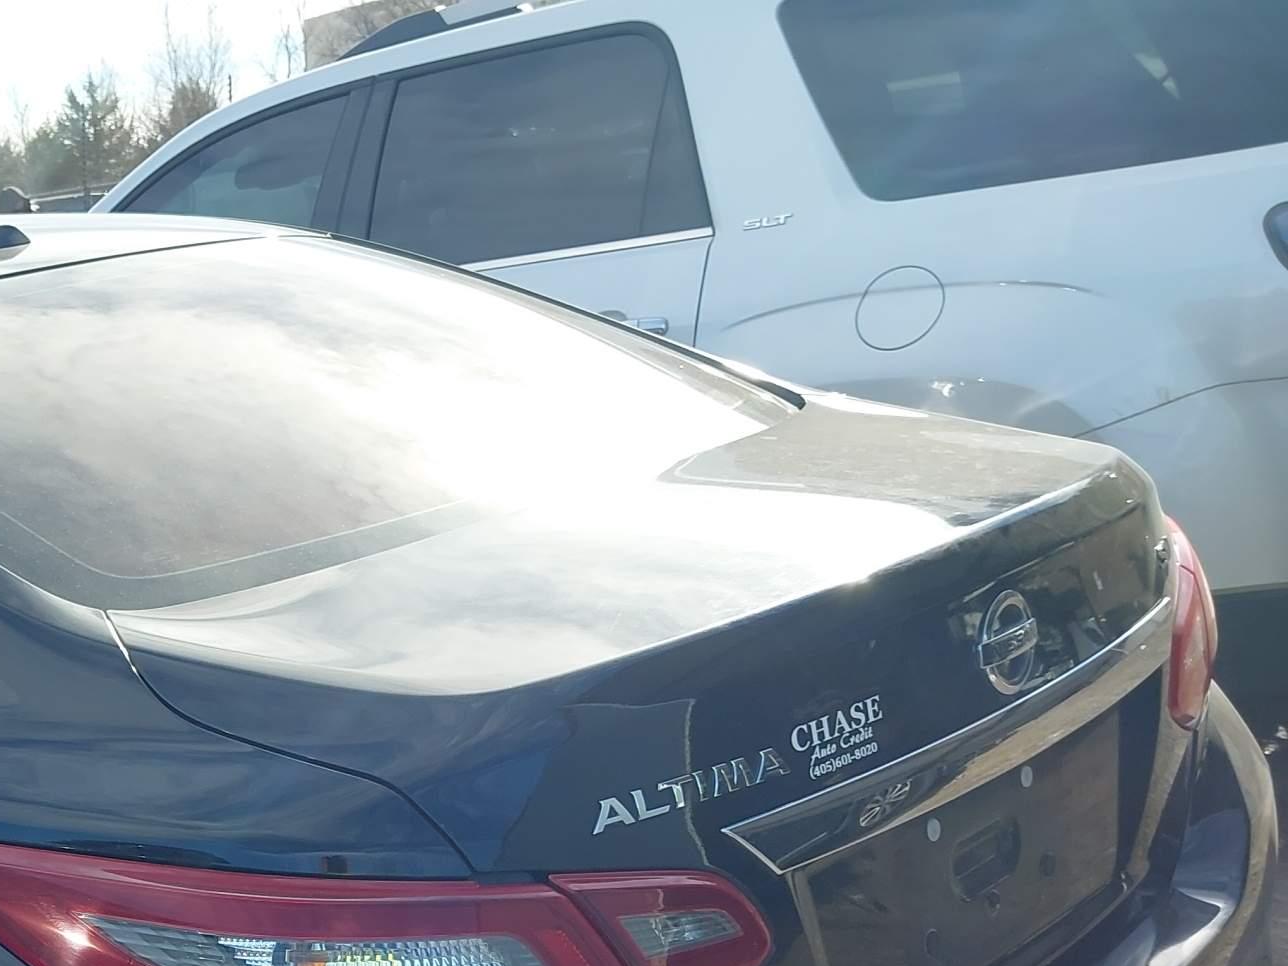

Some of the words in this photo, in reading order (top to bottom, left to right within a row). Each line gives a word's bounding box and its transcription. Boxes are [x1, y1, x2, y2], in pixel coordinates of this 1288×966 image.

[743, 212, 793, 231] SLT
[791, 695, 883, 752] CHASE
[809, 742, 879, 780] (405)601-8020
[810, 743, 837, 767] Auto
[839, 726, 874, 749] Credit
[592, 748, 791, 835] ALTIMA
